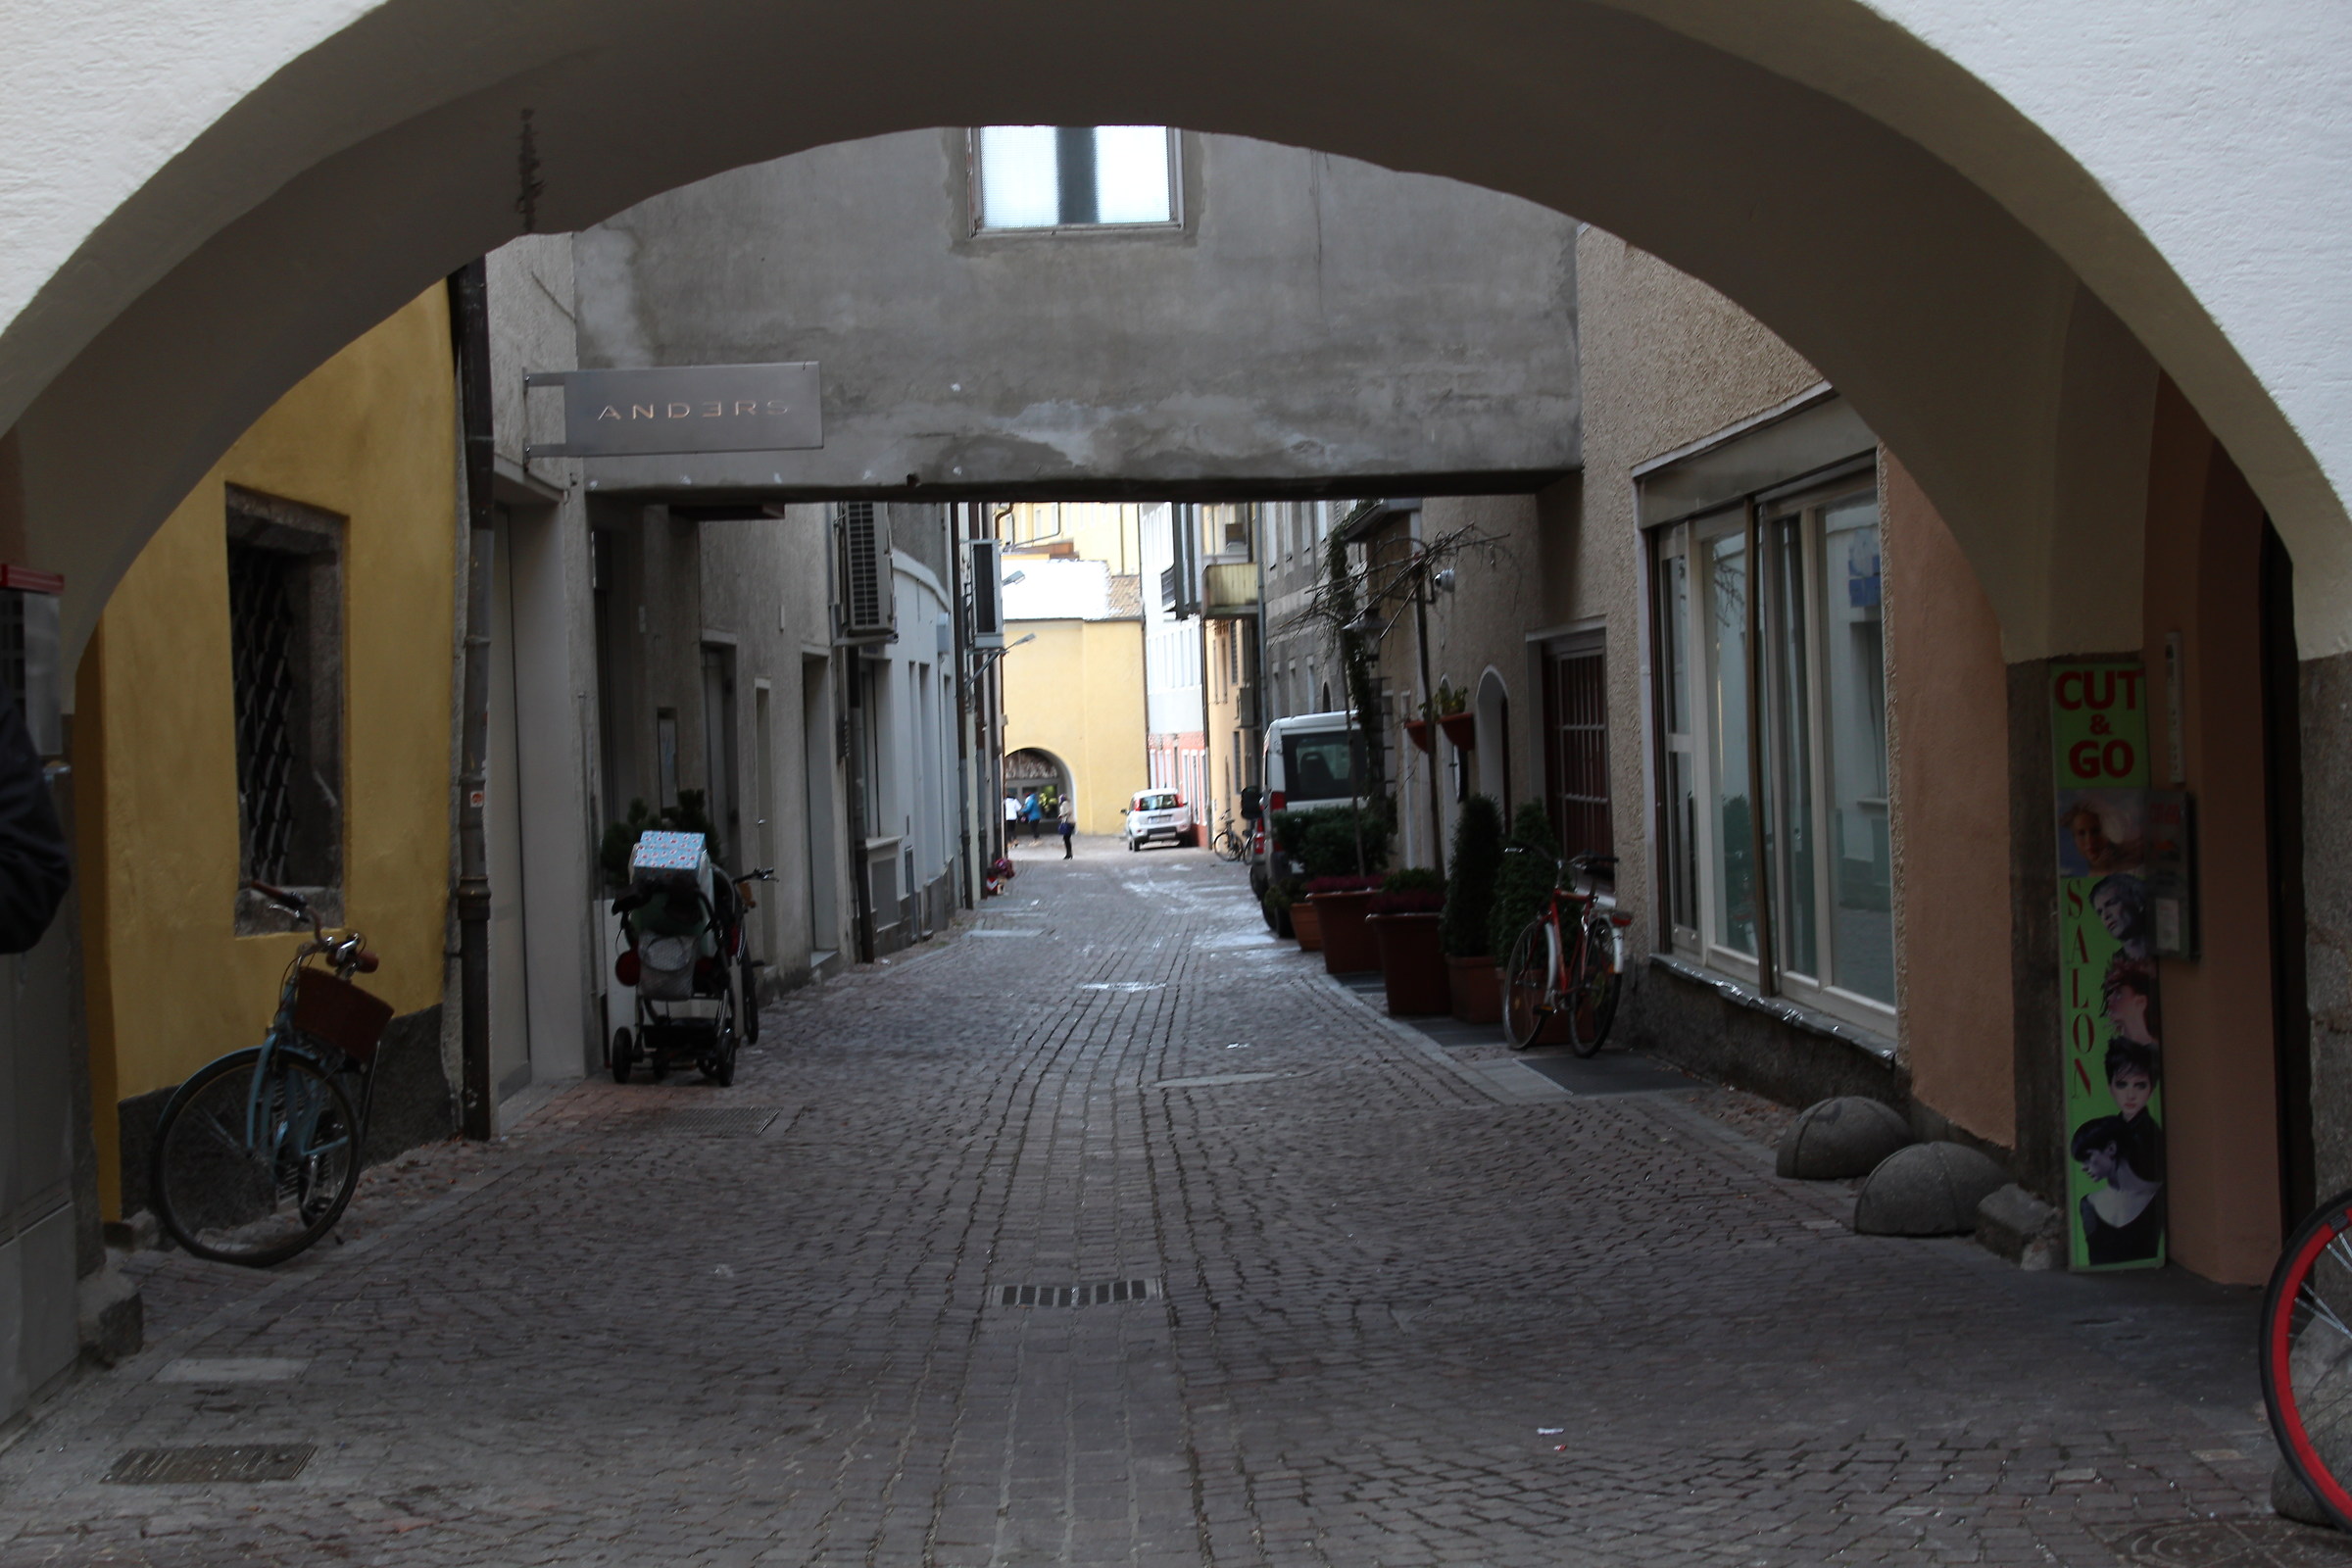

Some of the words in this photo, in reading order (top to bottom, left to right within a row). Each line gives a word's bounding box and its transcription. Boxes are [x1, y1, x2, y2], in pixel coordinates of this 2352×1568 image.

[2055, 669, 2144, 710] CUT
[2089, 713, 2113, 735] &
[2069, 739, 2134, 779] GO
[2066, 879, 2093, 1098] SALON
